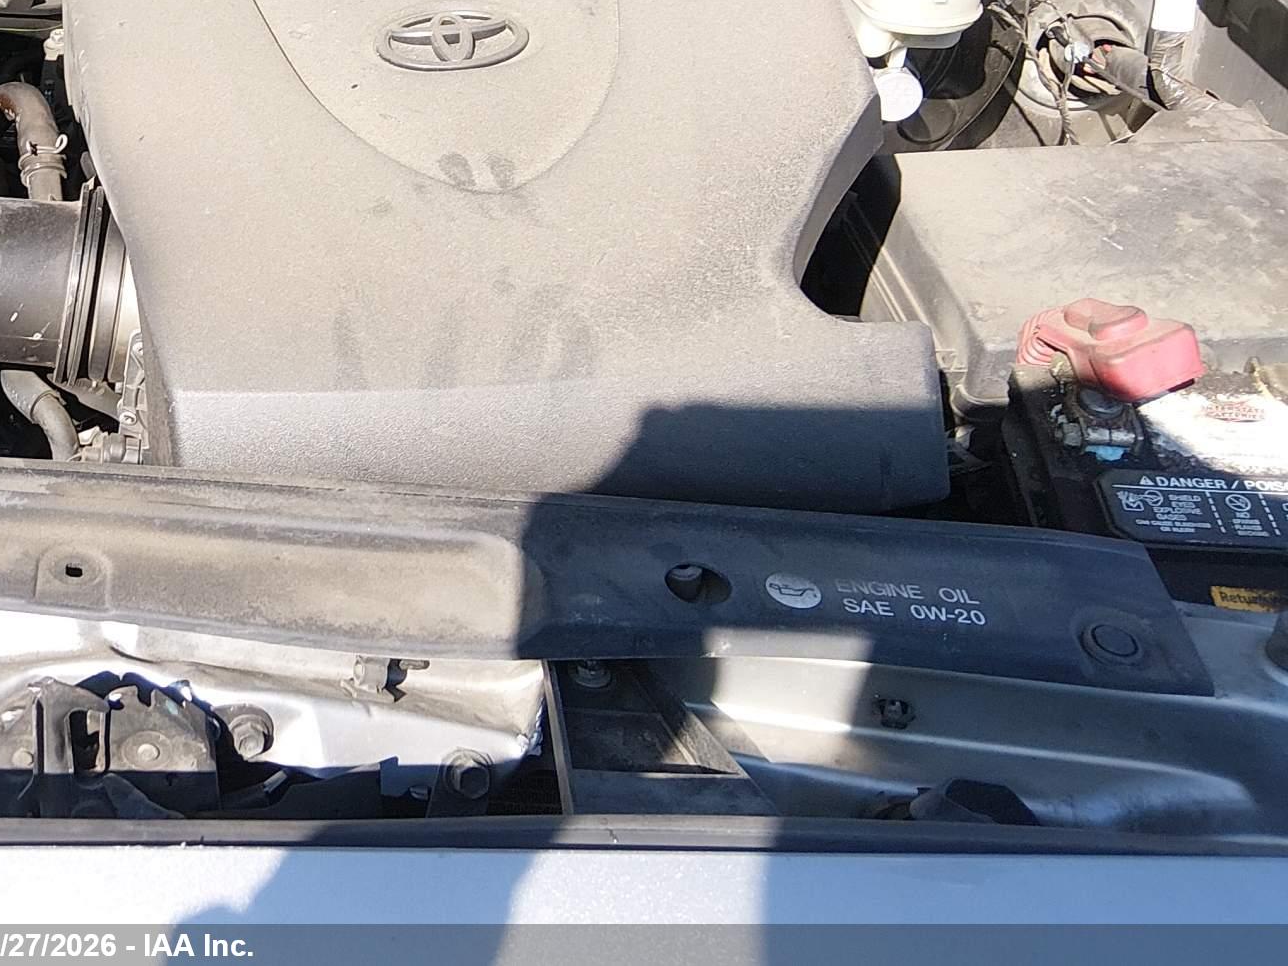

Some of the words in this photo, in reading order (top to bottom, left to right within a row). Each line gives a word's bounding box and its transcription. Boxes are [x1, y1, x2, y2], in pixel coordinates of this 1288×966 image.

[1155, 476, 1228, 490] DANGER
[1231, 480, 1240, 490] /
[835, 578, 923, 601] ENGINE
[939, 587, 981, 605] OIL
[844, 597, 894, 617] SAE
[910, 604, 986, 626] 0W-20
